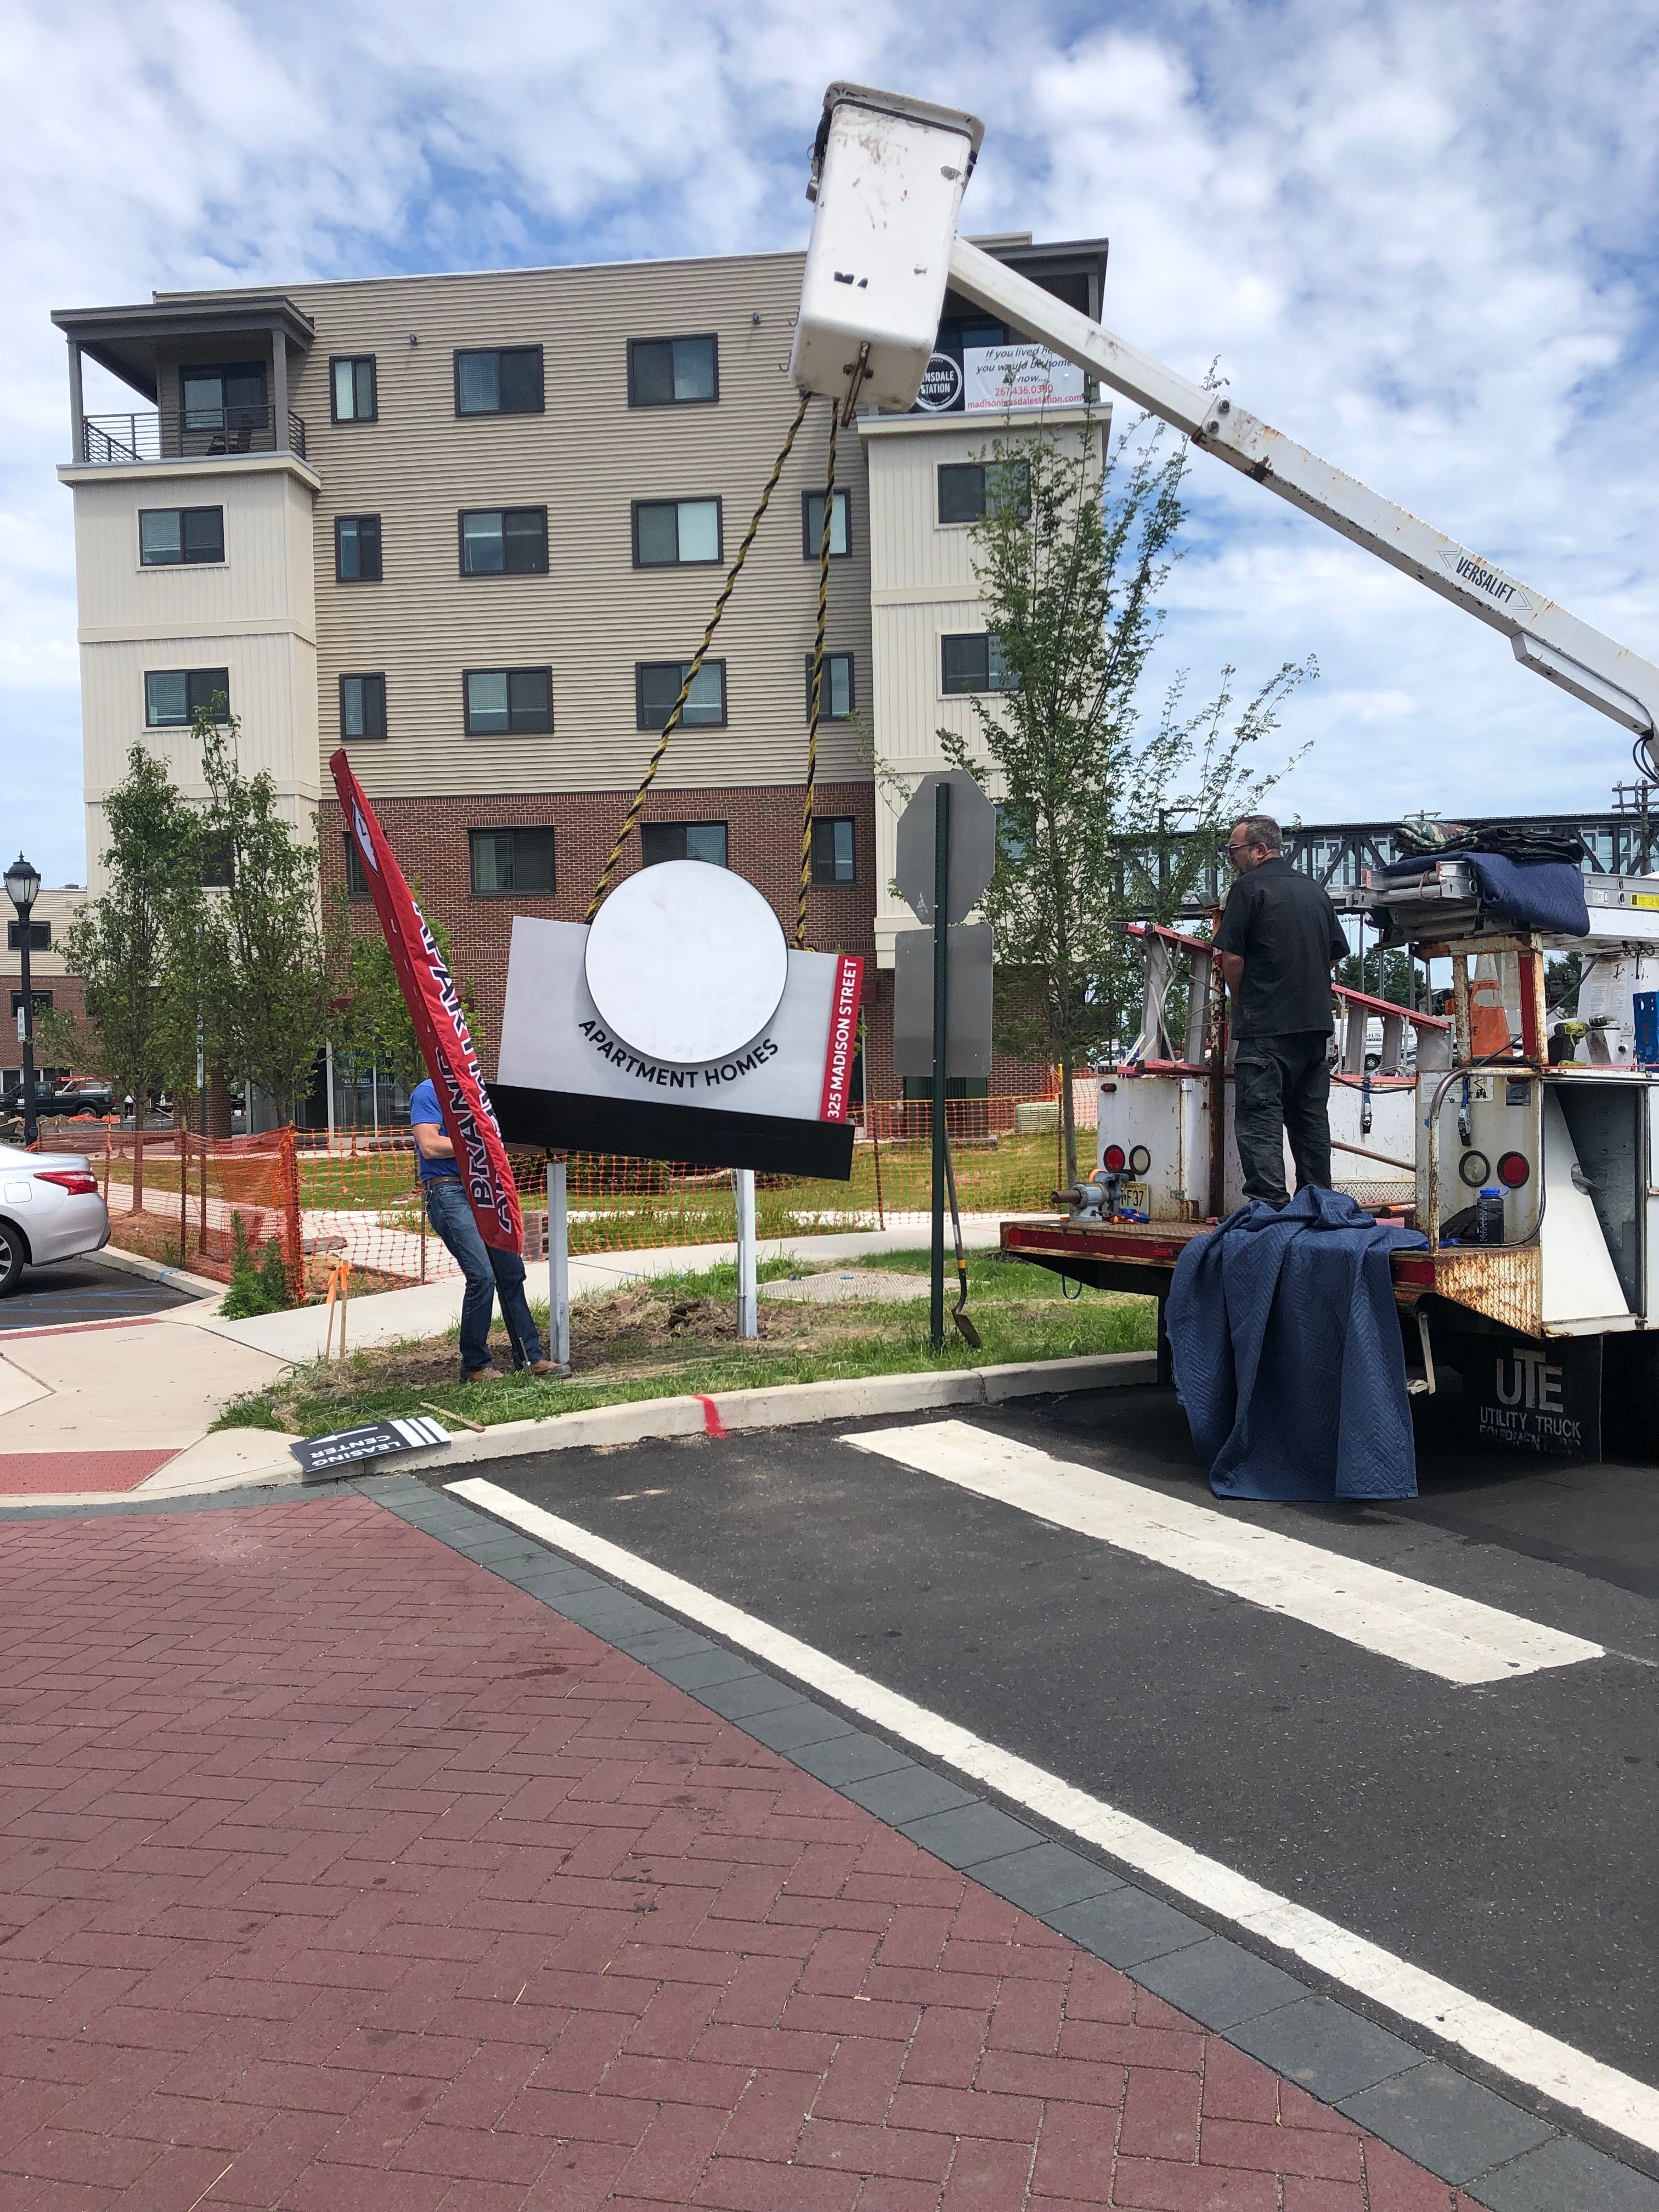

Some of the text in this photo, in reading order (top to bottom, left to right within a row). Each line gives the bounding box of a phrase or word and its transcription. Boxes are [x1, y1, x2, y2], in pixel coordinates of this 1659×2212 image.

[986, 349, 993, 358] If
[994, 351, 1013, 360] you
[1015, 346, 1040, 357] lived
[923, 370, 955, 382] NSDALE
[976, 363, 995, 374] you
[921, 383, 950, 394] STATION
[995, 383, 1053, 397] 267436.030
[1455, 556, 1516, 603] VERSALIFT
[827, 959, 857, 1119] 325 MADISON STREET
[578, 1020, 779, 1088] APARTMENT HOMES
[1496, 1348, 1564, 1413] UTE
[1480, 1406, 1582, 1439] UTILITY TRUCK
[310, 1435, 391, 1459] CENTER
[312, 1441, 401, 1466] LEASING
